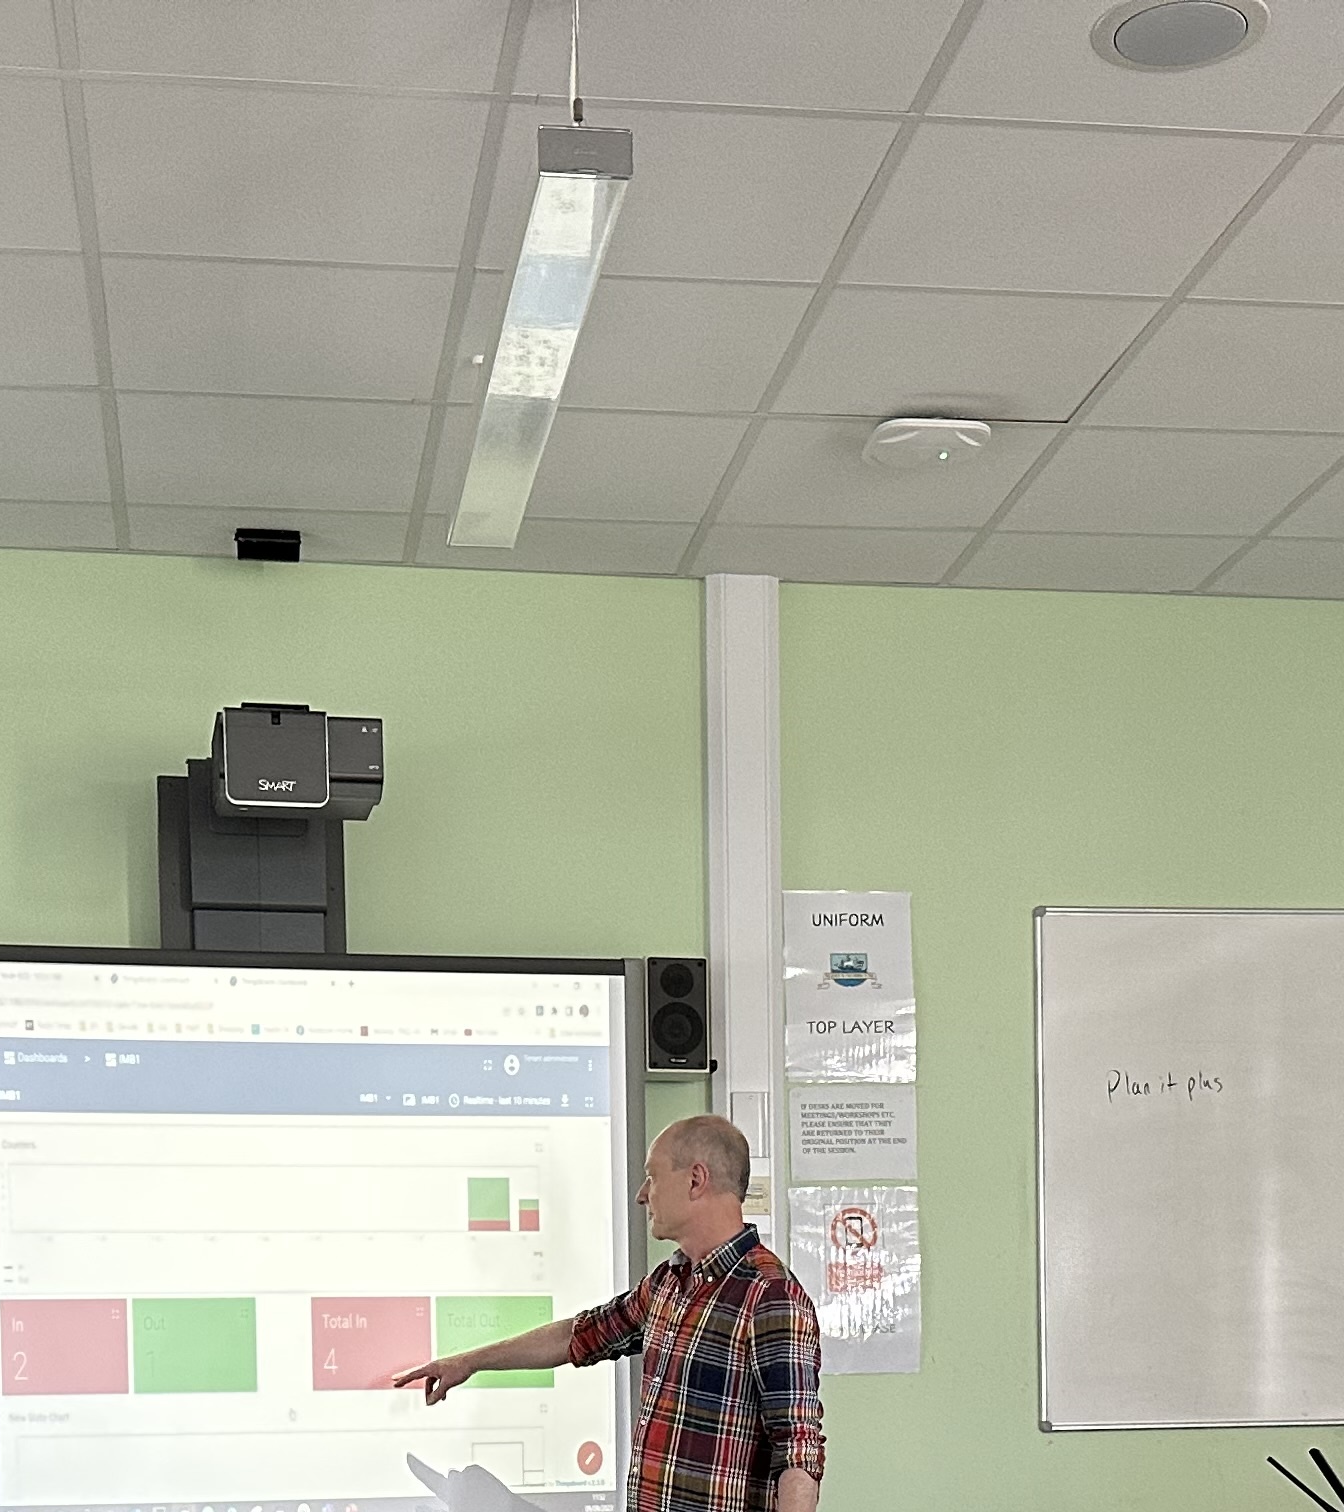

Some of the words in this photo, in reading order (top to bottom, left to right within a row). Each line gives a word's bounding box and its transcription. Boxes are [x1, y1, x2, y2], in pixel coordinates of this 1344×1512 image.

[258, 779, 297, 792] SMART
[812, 913, 885, 927] UNIFORM
[806, 1020, 837, 1034] TOP
[842, 1020, 895, 1034] LAYER
[17, 1052, 68, 1064] Dashboards
[1107, 1069, 1151, 1103] Plan
[1158, 1071, 1178, 1094] it
[1187, 1069, 1224, 1101] plus
[11, 1317, 24, 1333] In
[143, 1316, 166, 1331] Out
[321, 1313, 354, 1329] Total
[356, 1314, 367, 1329] In
[447, 1312, 476, 1328] Total
[478, 1312, 501, 1327] Out
[12, 1351, 29, 1381] 2
[323, 1348, 339, 1375] 4
